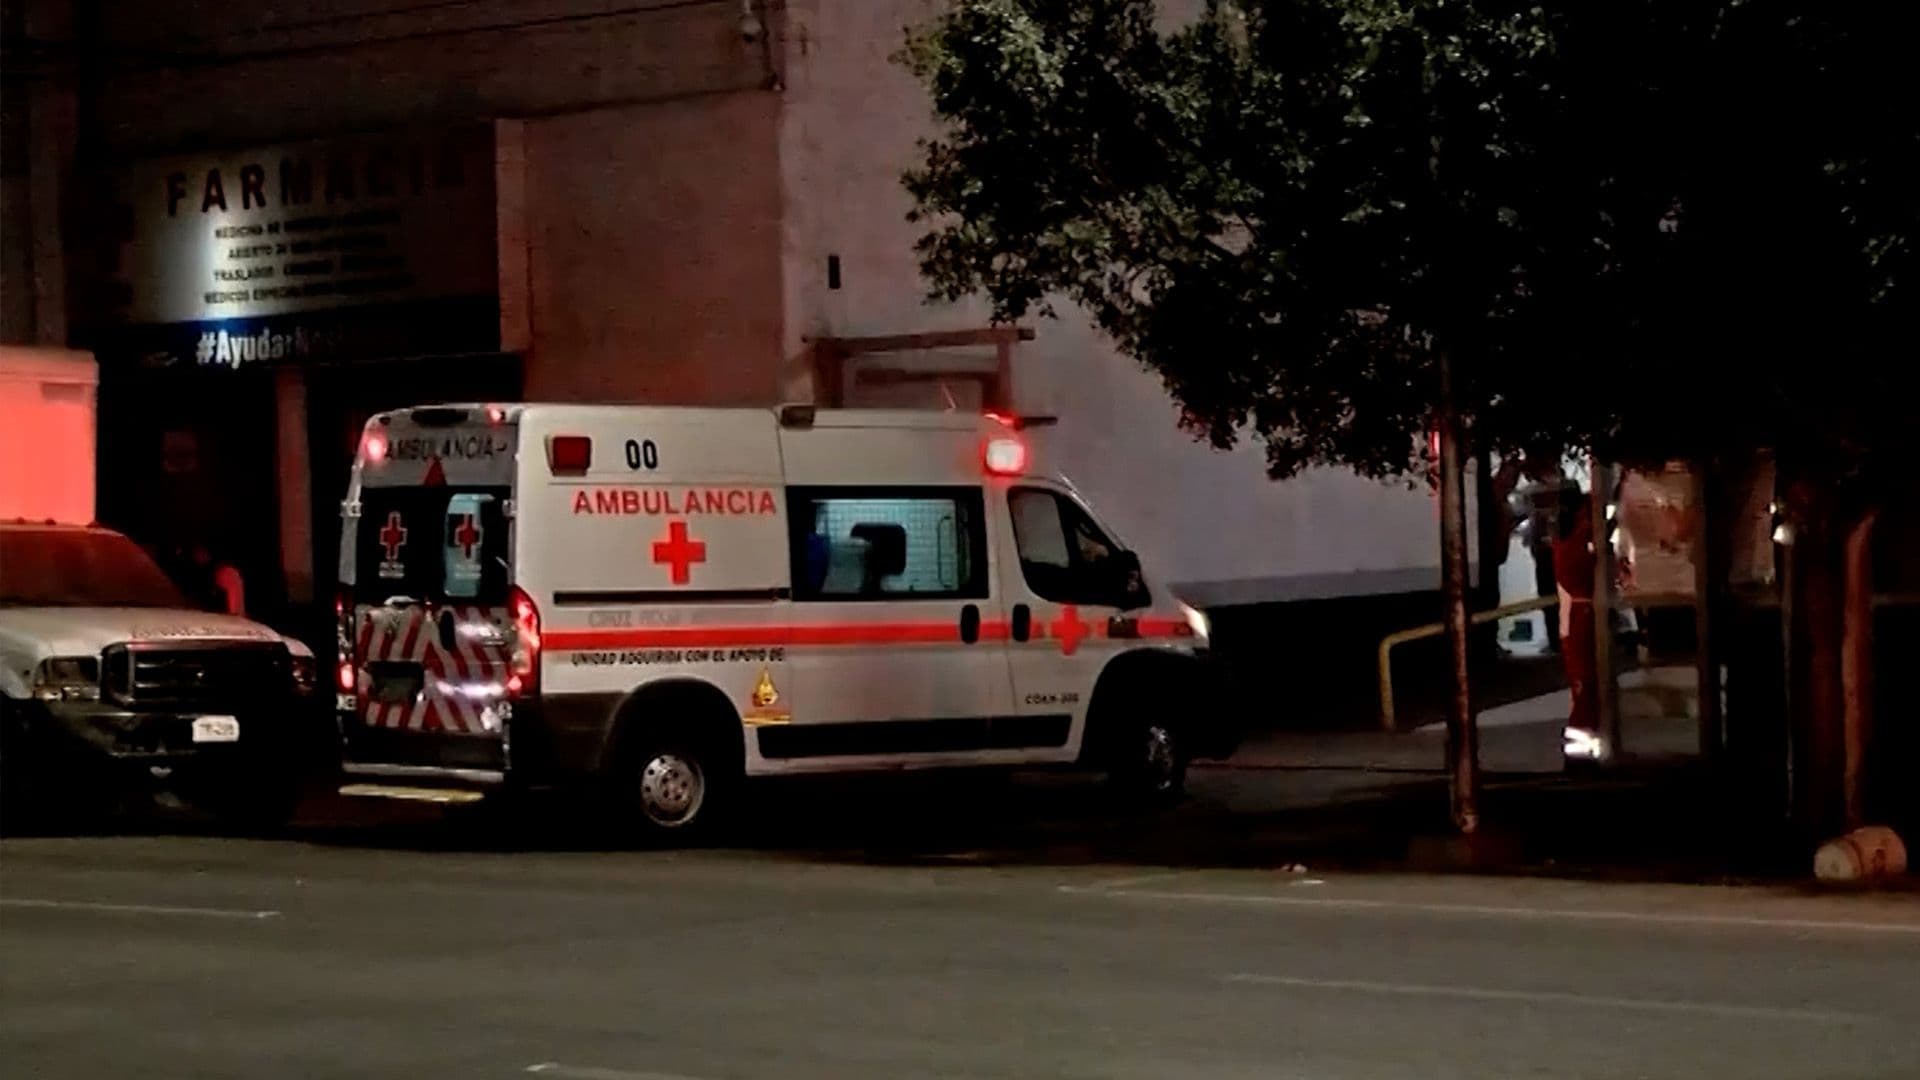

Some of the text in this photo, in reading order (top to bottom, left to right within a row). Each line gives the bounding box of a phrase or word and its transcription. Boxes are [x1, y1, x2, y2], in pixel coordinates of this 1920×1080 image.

[385, 436, 493, 459] AMBULANCIA
[573, 490, 777, 515] AMBULANCIA
[571, 648, 784, 665] UNIDAD ADQUIRIDA CON EL APOYO DE
